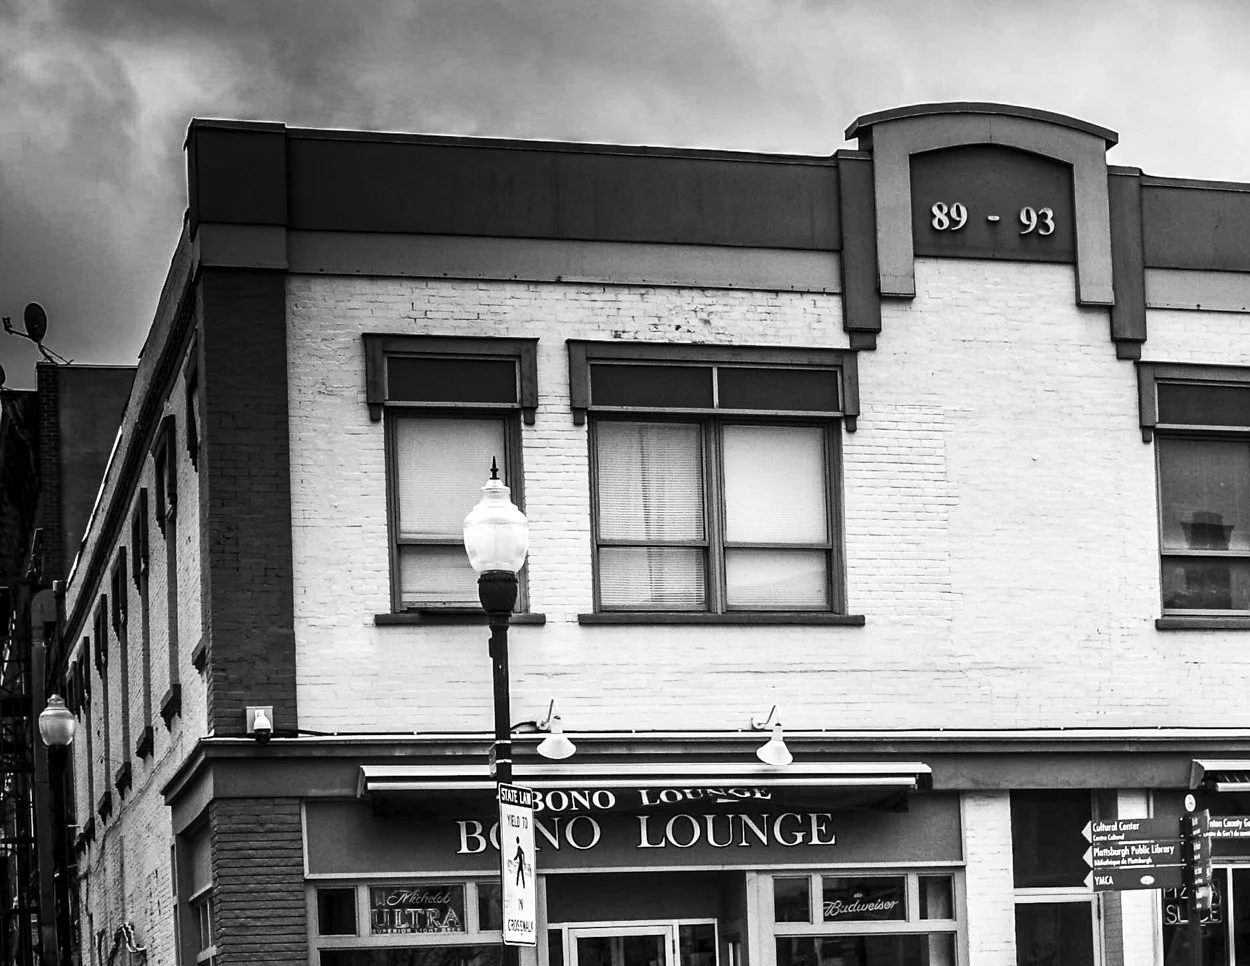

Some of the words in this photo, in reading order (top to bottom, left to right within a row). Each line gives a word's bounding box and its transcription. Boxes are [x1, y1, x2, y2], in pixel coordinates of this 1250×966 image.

[931, 201, 968, 231] 89
[1019, 206, 1055, 236] 93
[501, 787, 518, 804] STATE
[532, 789, 616, 812] BONO
[637, 787, 772, 806] LOUNGE
[1092, 821, 1118, 832] Cultural
[1118, 821, 1140, 832] Center
[1209, 819, 1223, 828] nton
[1223, 818, 1243, 829] County
[456, 815, 602, 854] BNO
[636, 812, 836, 848] LOUNGE
[1093, 846, 1130, 858] Plattsburgh
[1130, 844, 1150, 855] Public
[1151, 843, 1175, 855] Library
[1094, 875, 1114, 886] YMCA
[386, 889, 451, 906] Michelob
[823, 899, 899, 917] Budweiser
[372, 908, 461, 929] ULTRA
